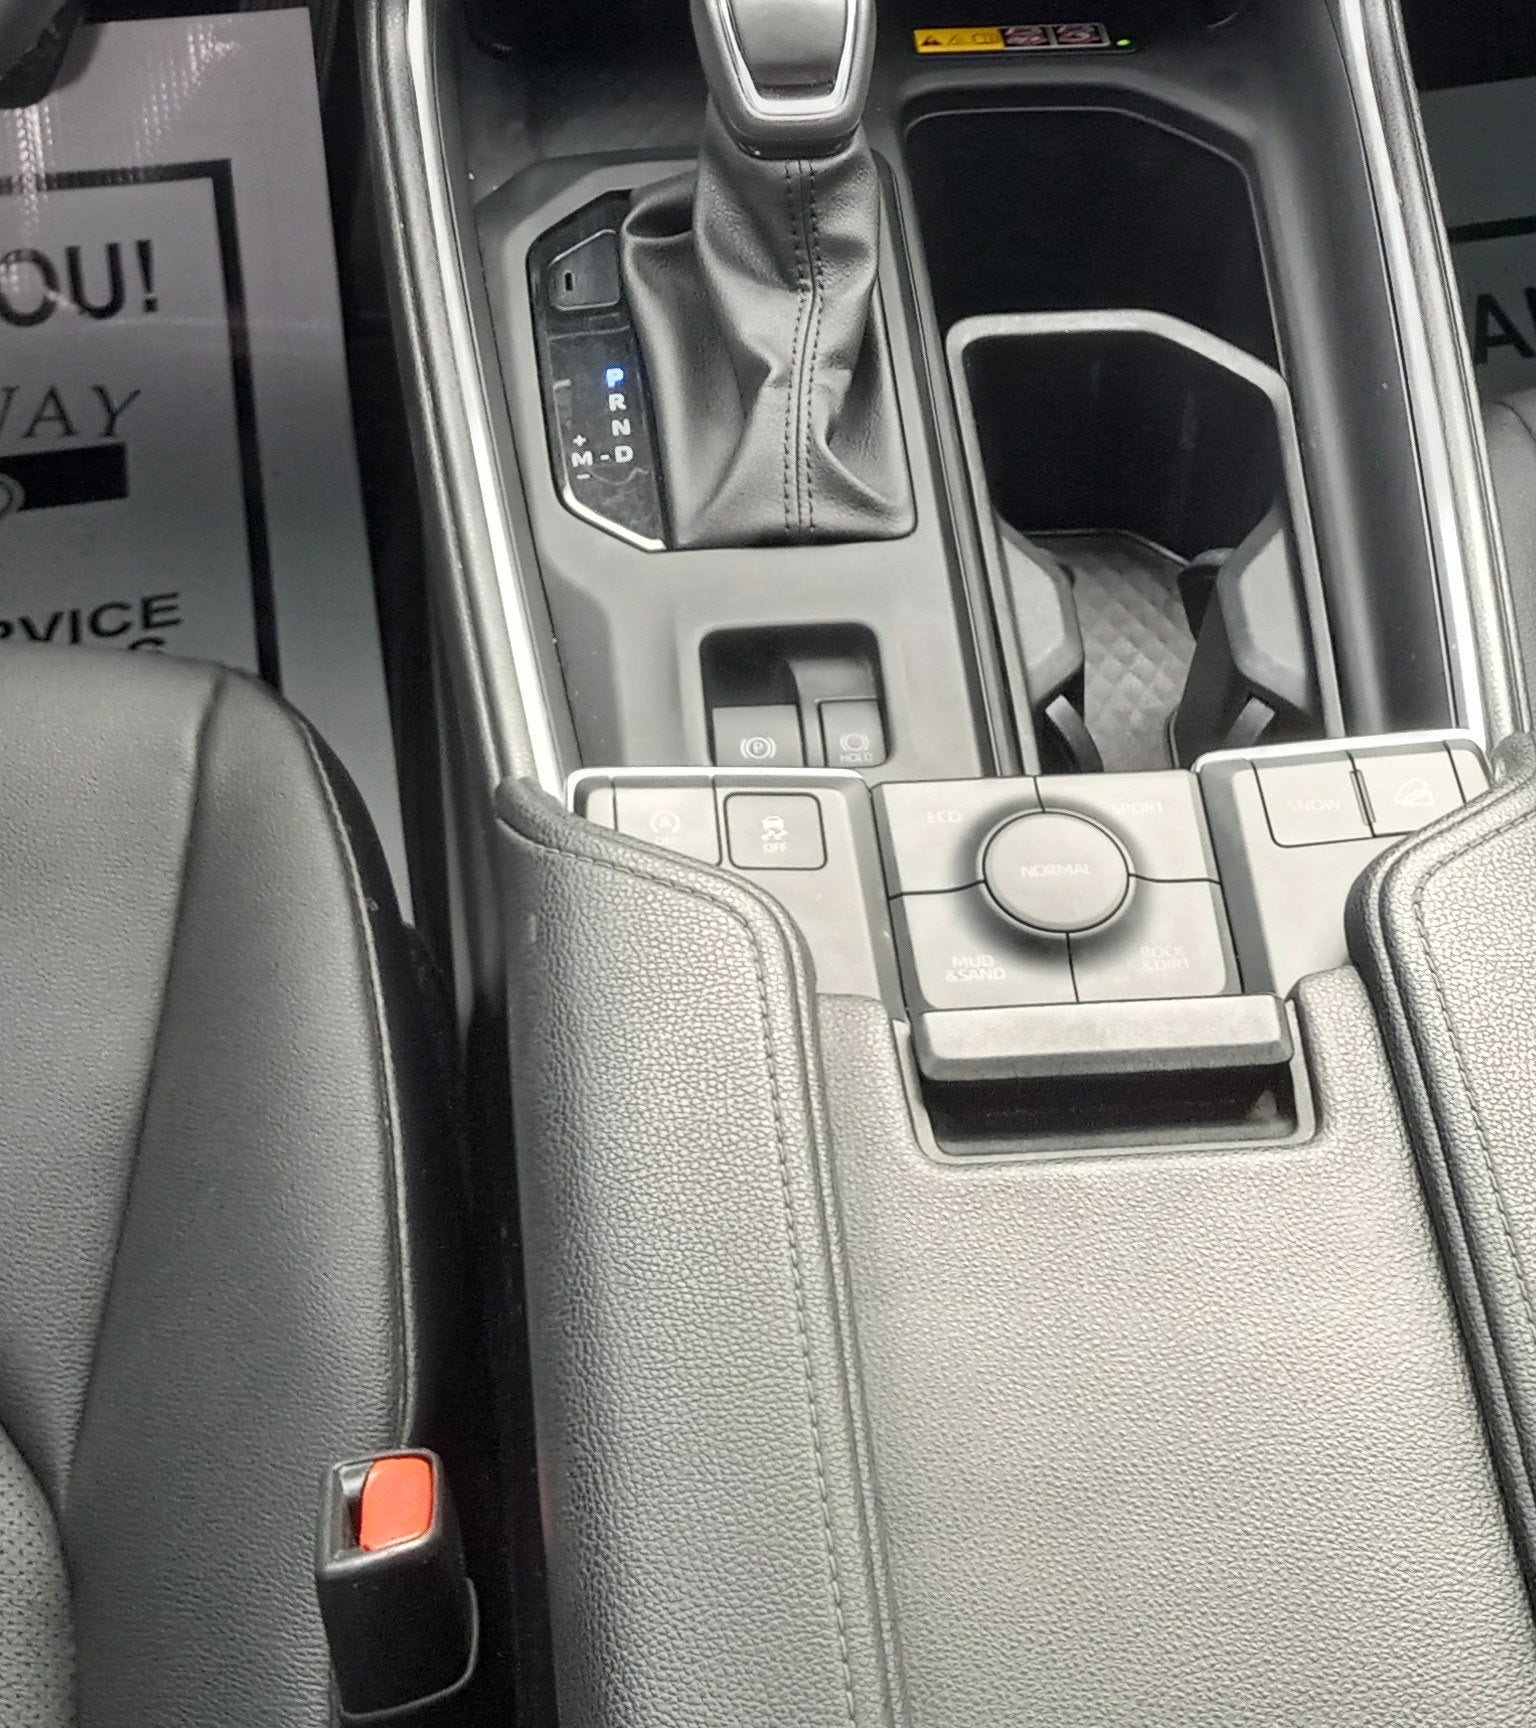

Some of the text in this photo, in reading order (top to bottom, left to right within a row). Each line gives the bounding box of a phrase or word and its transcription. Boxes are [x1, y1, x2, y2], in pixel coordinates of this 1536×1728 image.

[605, 367, 624, 387] P
[608, 393, 626, 411] R
[612, 418, 631, 436] N
[571, 445, 634, 467] M D
[839, 753, 873, 762] HOLD
[1110, 801, 1164, 816] SPORT
[927, 810, 963, 823] ECO
[762, 842, 787, 853] OFF
[1021, 864, 1090, 878] NORMAL
[951, 954, 995, 968] MUD
[945, 966, 1007, 983] &SAND
